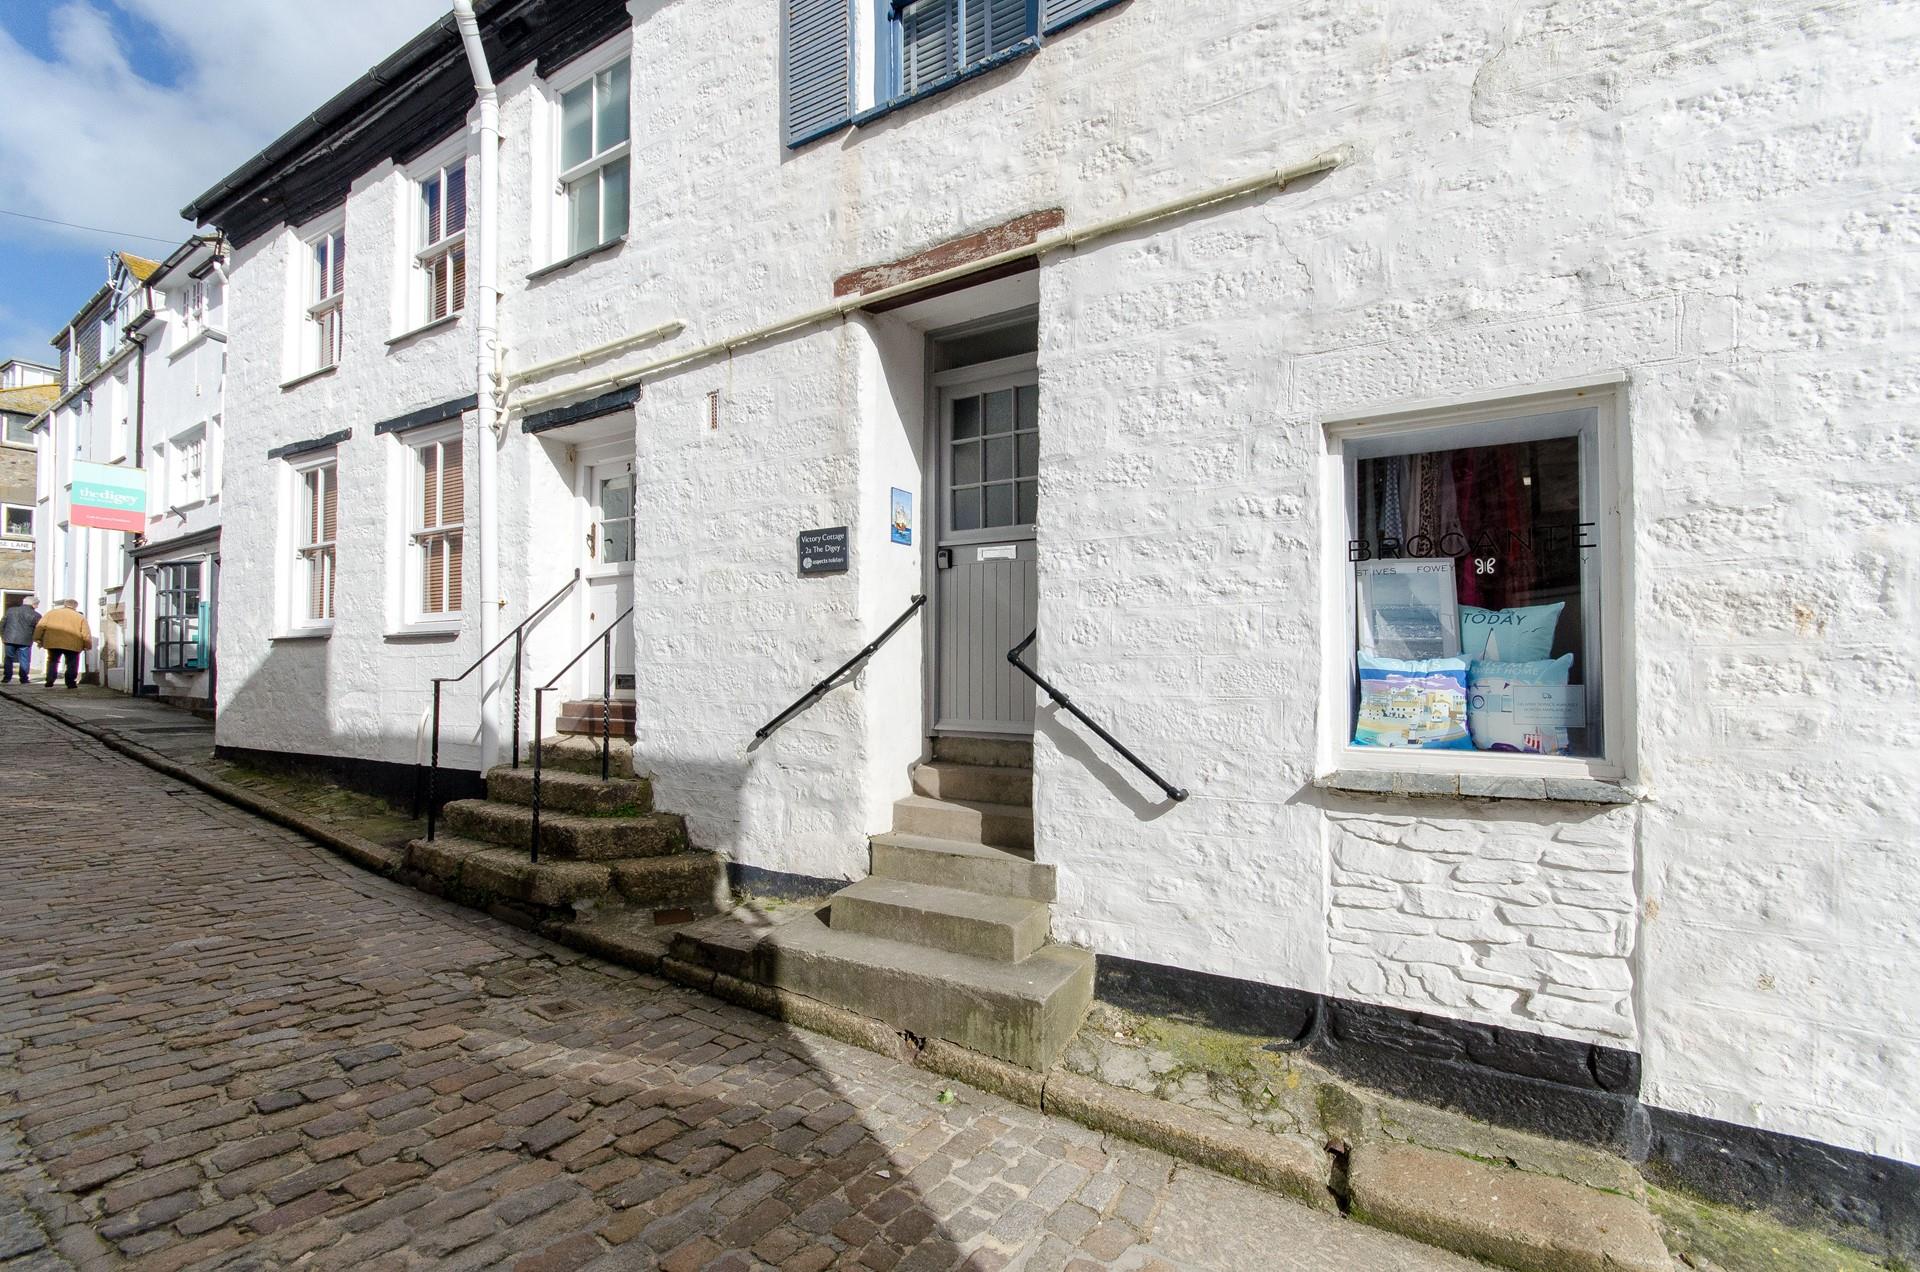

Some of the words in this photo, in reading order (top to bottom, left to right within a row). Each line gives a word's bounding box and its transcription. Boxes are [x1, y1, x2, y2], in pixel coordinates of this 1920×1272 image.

[801, 535, 821, 543] Victory
[822, 533, 844, 541] Cottage
[1348, 522, 1597, 562] BROCANTE
[825, 545, 840, 553] Digey
[1356, 569, 1368, 577] ST
[1372, 567, 1397, 576] IVES
[1416, 564, 1455, 574] FOWEY
[1464, 612, 1527, 626] TODAY
[1503, 666, 1538, 676] HOME
